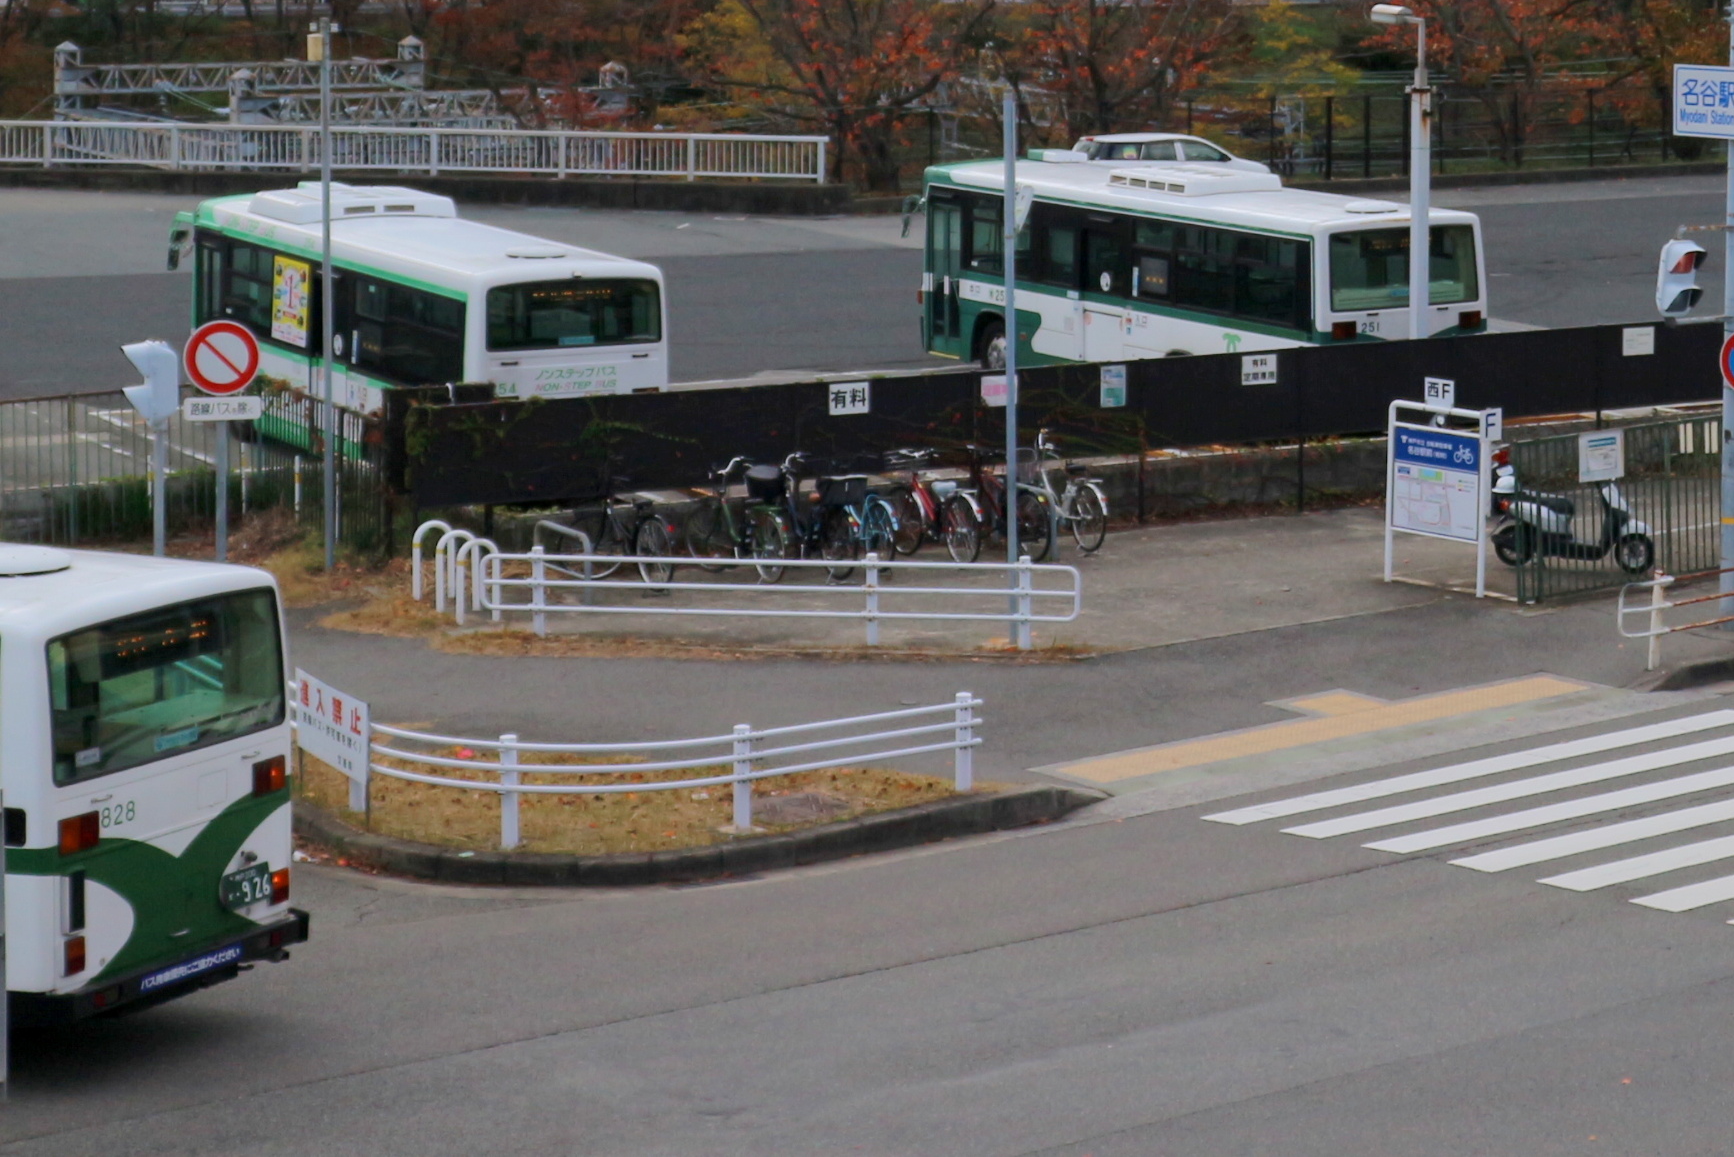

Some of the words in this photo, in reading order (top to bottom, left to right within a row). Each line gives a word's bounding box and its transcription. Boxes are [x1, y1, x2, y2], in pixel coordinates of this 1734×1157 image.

[1680, 109, 1708, 125] Myodani
[1710, 110, 1734, 126] Station
[1361, 322, 1380, 334] 251
[535, 366, 617, 381] ノンステップバス
[535, 381, 592, 392] NON-STEP
[596, 379, 617, 389] BUS
[831, 387, 866, 409] 有料
[190, 402, 253, 416] 路線バスを除く
[1485, 412, 1497, 439] F
[300, 679, 362, 736] 進入禁止
[101, 800, 136, 829] 828
